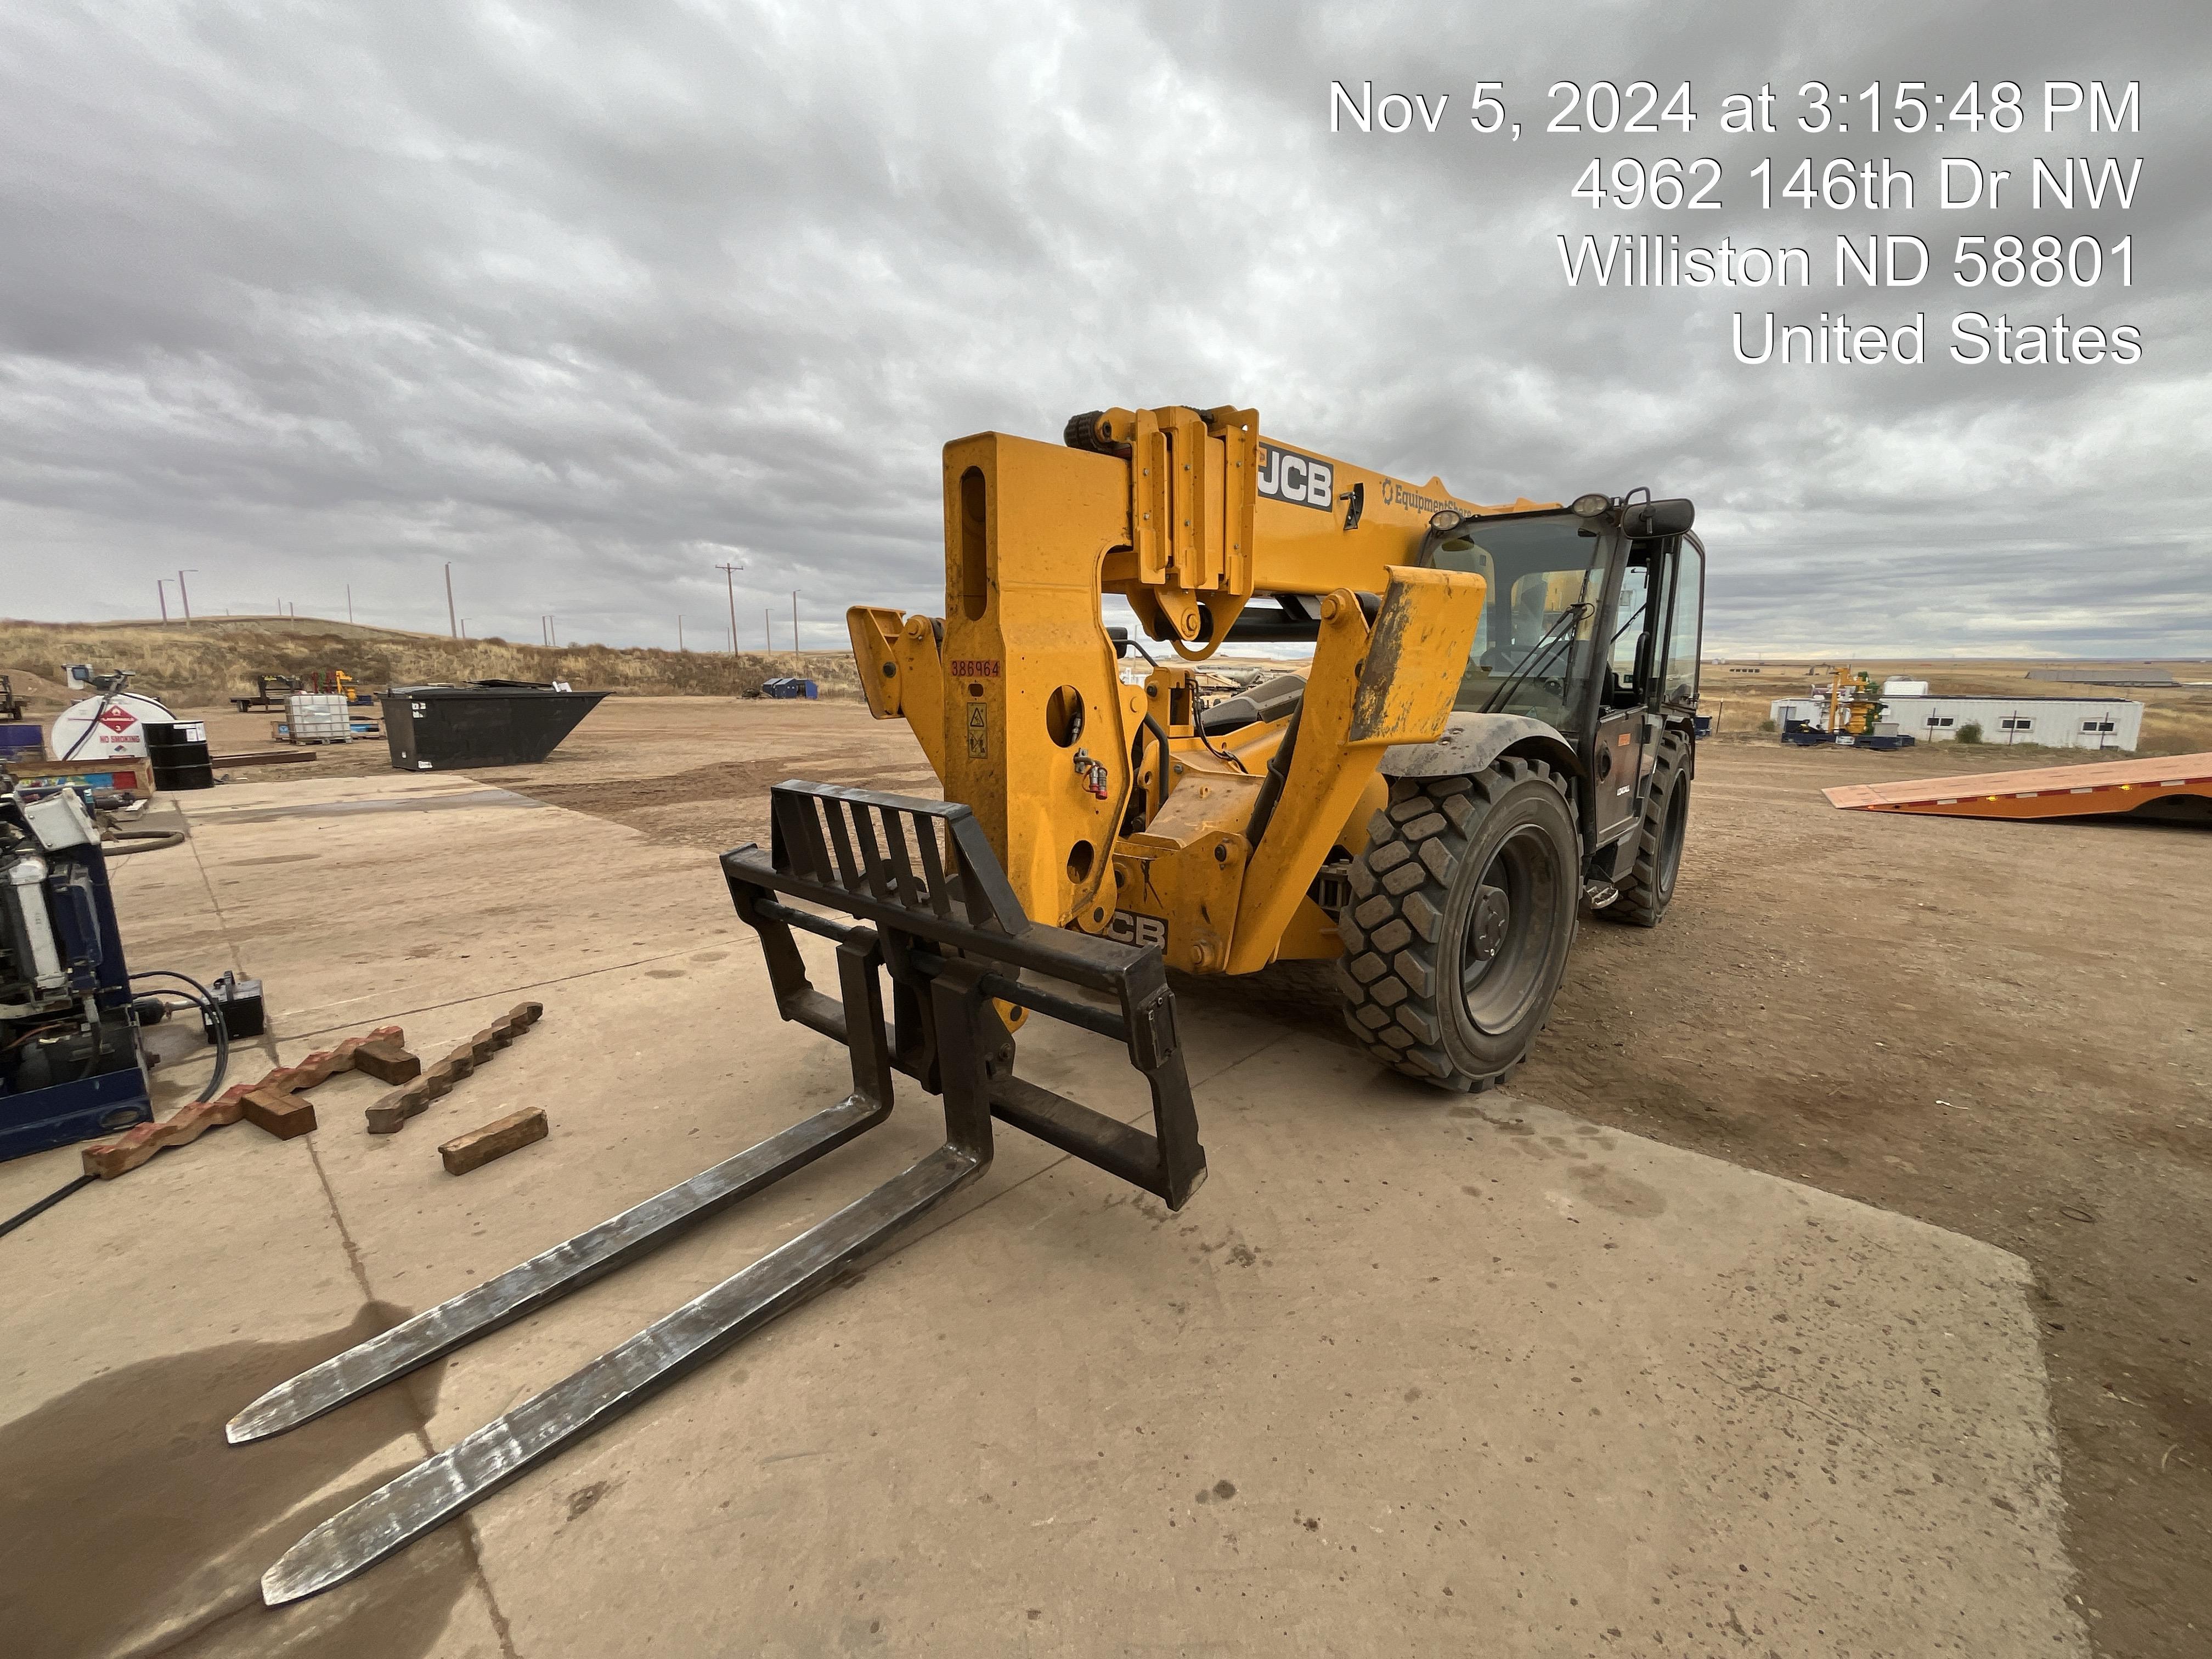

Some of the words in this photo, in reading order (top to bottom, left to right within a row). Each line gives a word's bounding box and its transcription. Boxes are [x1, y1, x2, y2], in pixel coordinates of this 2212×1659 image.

[1257, 451, 1331, 507] JCB
[952, 661, 998, 676] 386964
[1108, 911, 1165, 950] CB
